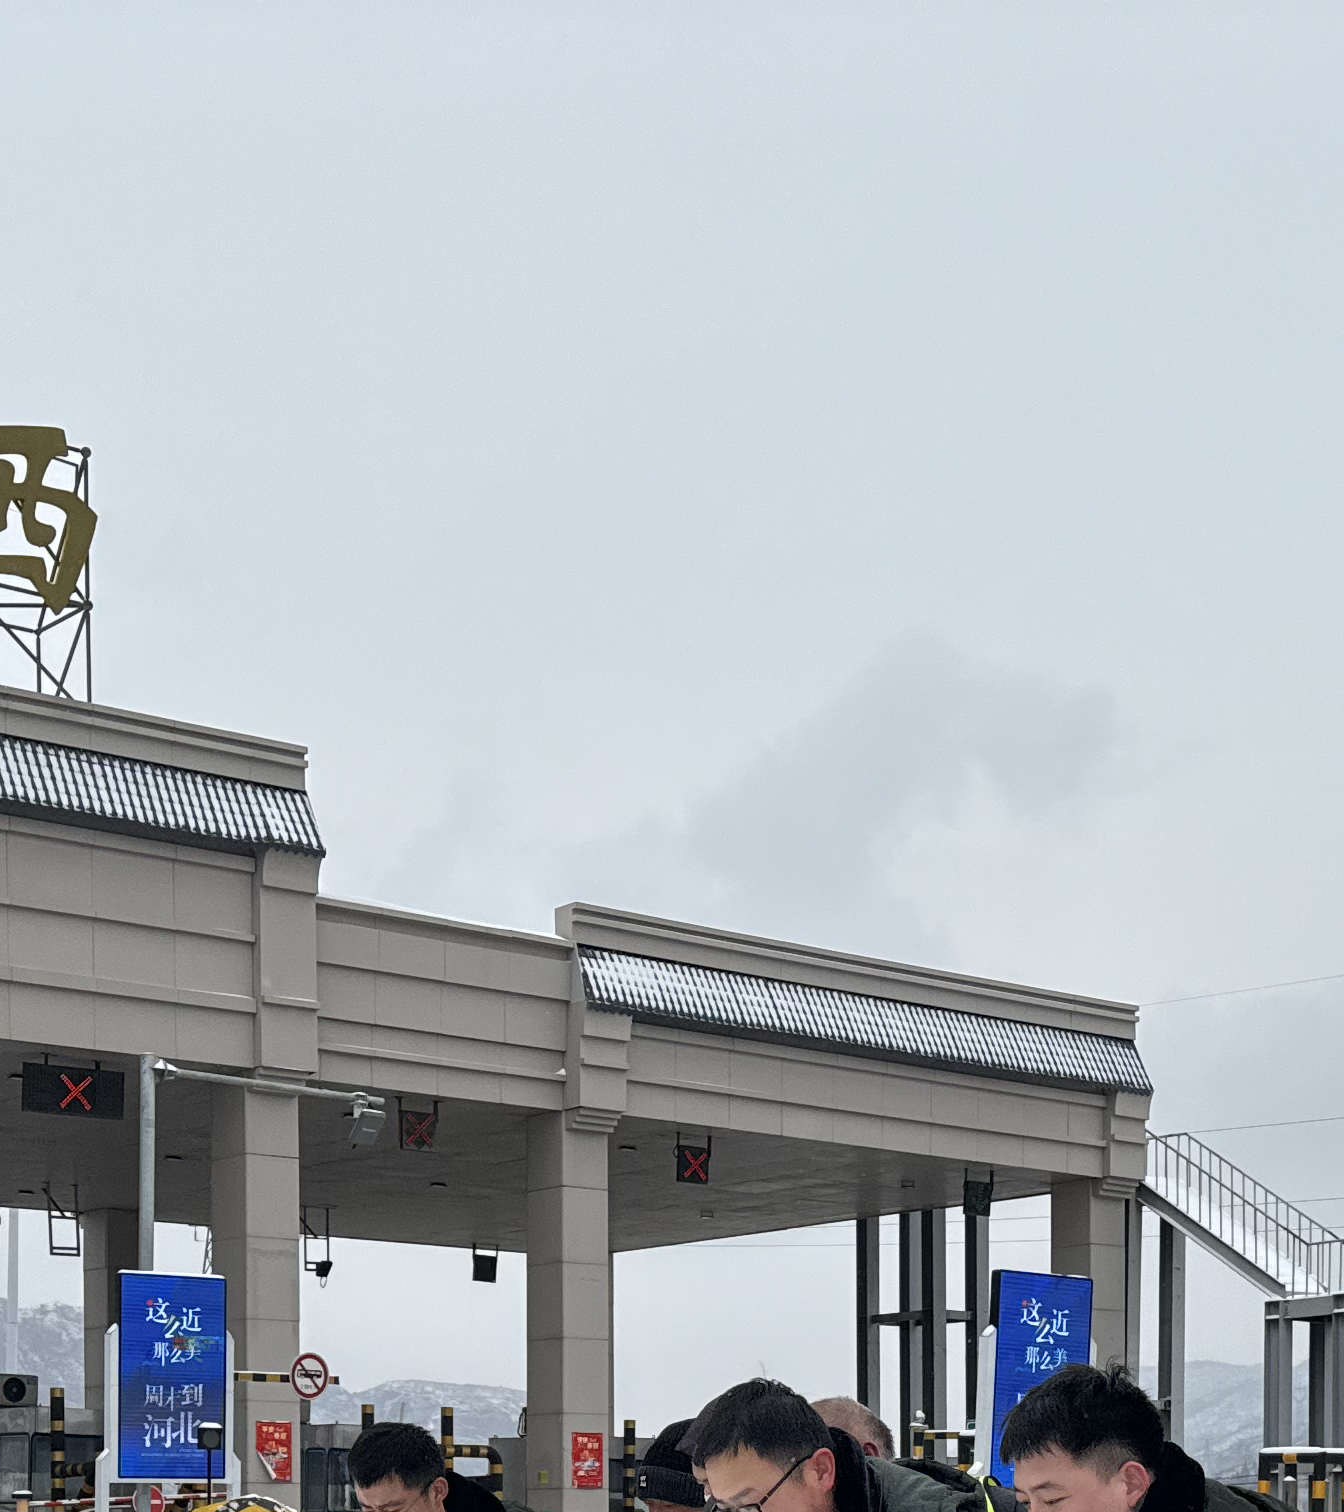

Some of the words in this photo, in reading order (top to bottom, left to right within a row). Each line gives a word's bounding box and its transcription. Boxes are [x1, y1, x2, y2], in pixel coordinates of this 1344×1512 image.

[145, 1297, 202, 1338] 这么近
[1020, 1297, 1070, 1345] 这么近
[1024, 1345, 1068, 1373] 那么美
[143, 1383, 204, 1412] 周末到
[142, 1411, 201, 1448] 河北
